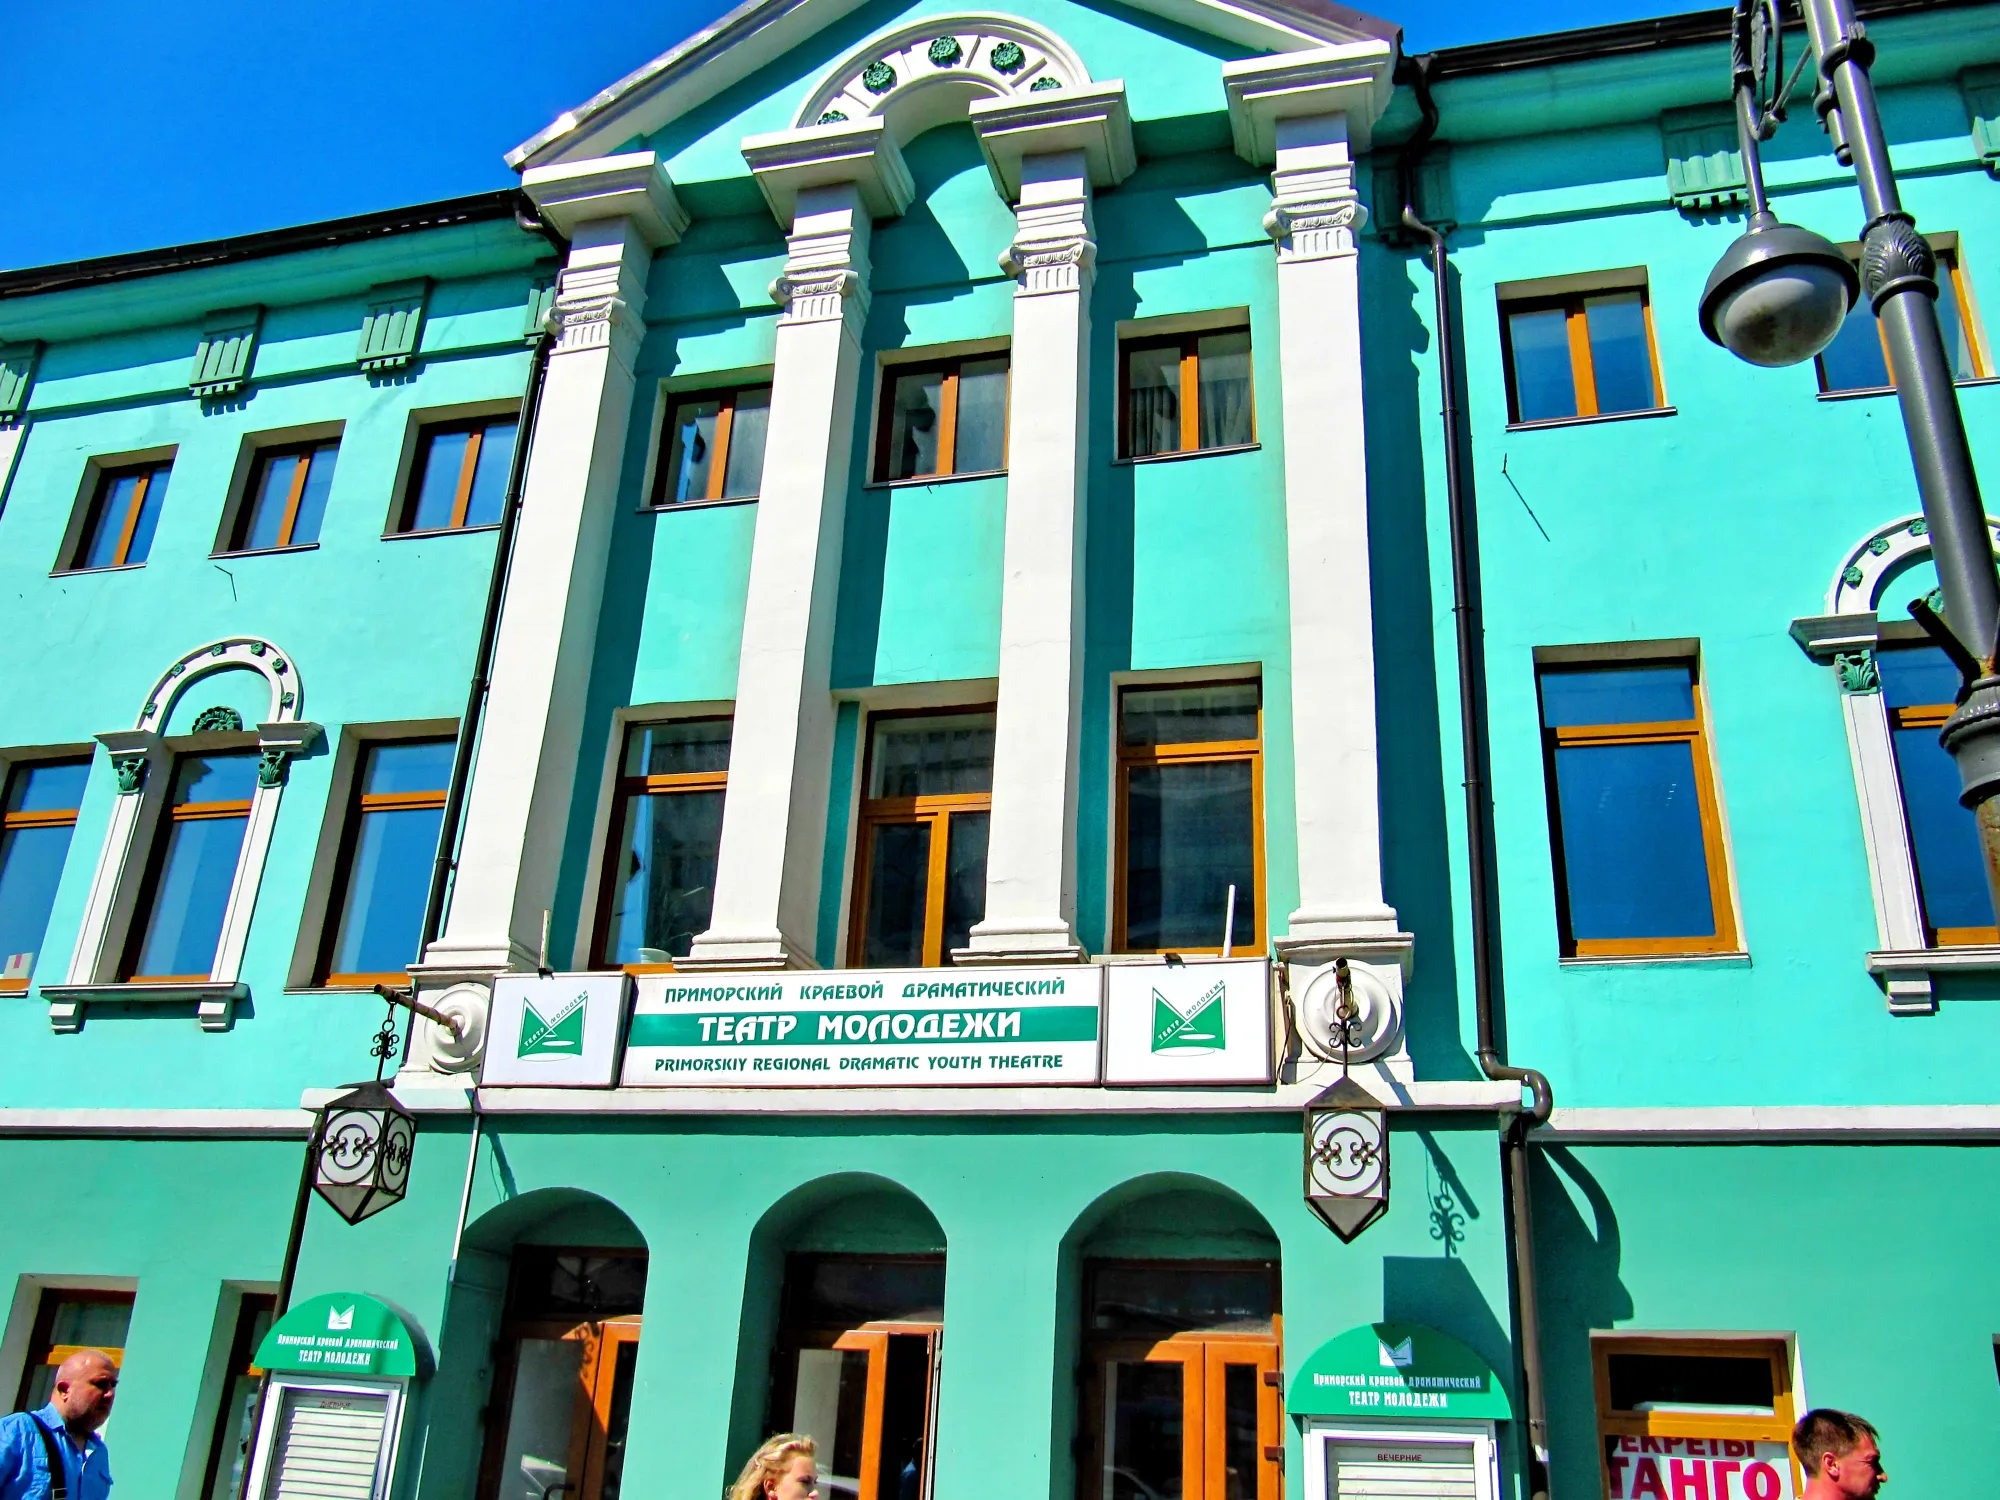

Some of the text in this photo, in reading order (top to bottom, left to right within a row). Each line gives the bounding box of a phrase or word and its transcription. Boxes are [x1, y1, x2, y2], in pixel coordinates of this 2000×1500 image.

[665, 976, 1065, 1004] ПРИМОРСКИЙ КРАЕВОЙ ДРАМАТИЧЕСКИЙ
[524, 1027, 545, 1047] ТЕАТР
[697, 1011, 1021, 1044] ТЕАТР МОЛОДЕЖИ
[1157, 1019, 1180, 1041] ТЕАТР
[655, 1054, 1063, 1073] PRIMORSKIY REGIONAL DRAMATIC YOUTH THEATRE
[277, 1333, 315, 1346] Приморский
[299, 1349, 371, 1366] ТЕАТР МОЛОДЕЖИ
[1313, 1372, 1481, 1389] Приморский краевой драматический
[1348, 1391, 1448, 1408] ТЕАТР МОЛОДЕЖИ
[1377, 1453, 1423, 1462] ВЕЧЕРНИЕ
[1606, 1456, 1782, 1500] ТАНГО
